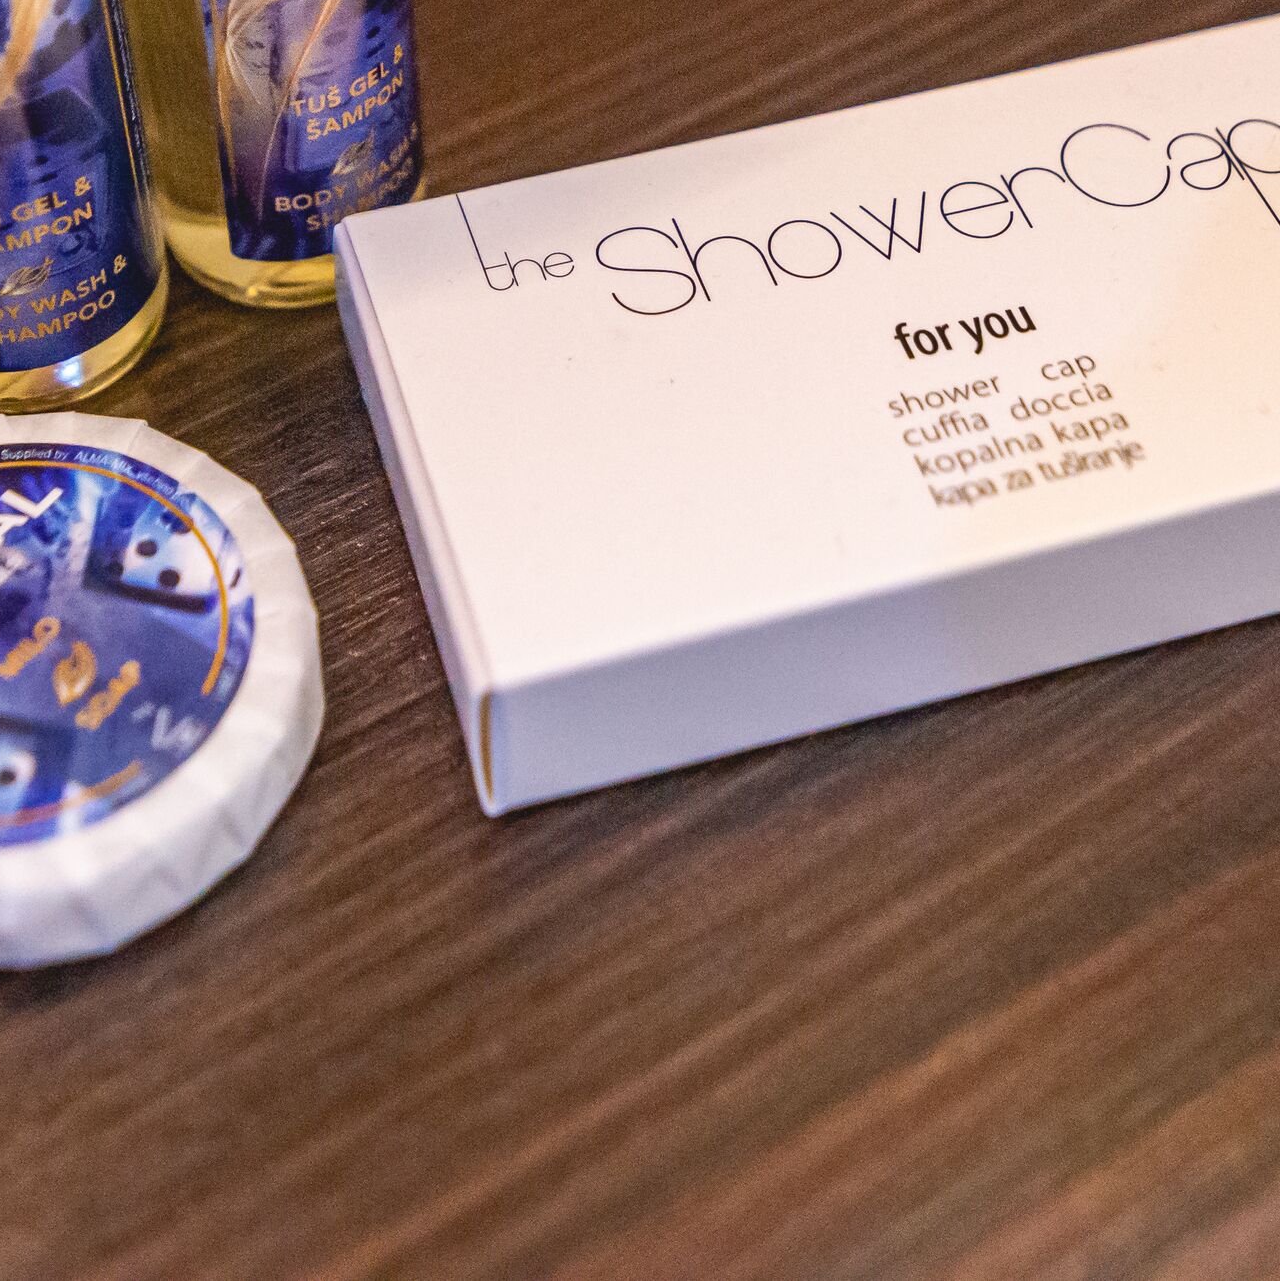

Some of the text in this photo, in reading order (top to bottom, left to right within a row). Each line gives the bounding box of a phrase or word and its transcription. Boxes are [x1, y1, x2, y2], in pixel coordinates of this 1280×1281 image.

[349, 62, 389, 98] GEL
[11, 191, 67, 221] GEL
[73, 176, 91, 196] &
[455, 193, 575, 291] the
[29, 268, 107, 315] WASH
[113, 254, 128, 275] &
[894, 306, 1037, 360] for you
[888, 354, 1097, 418] shower cap
[902, 381, 1113, 448] cuffia doccia
[913, 410, 1131, 478] kopalna kapa
